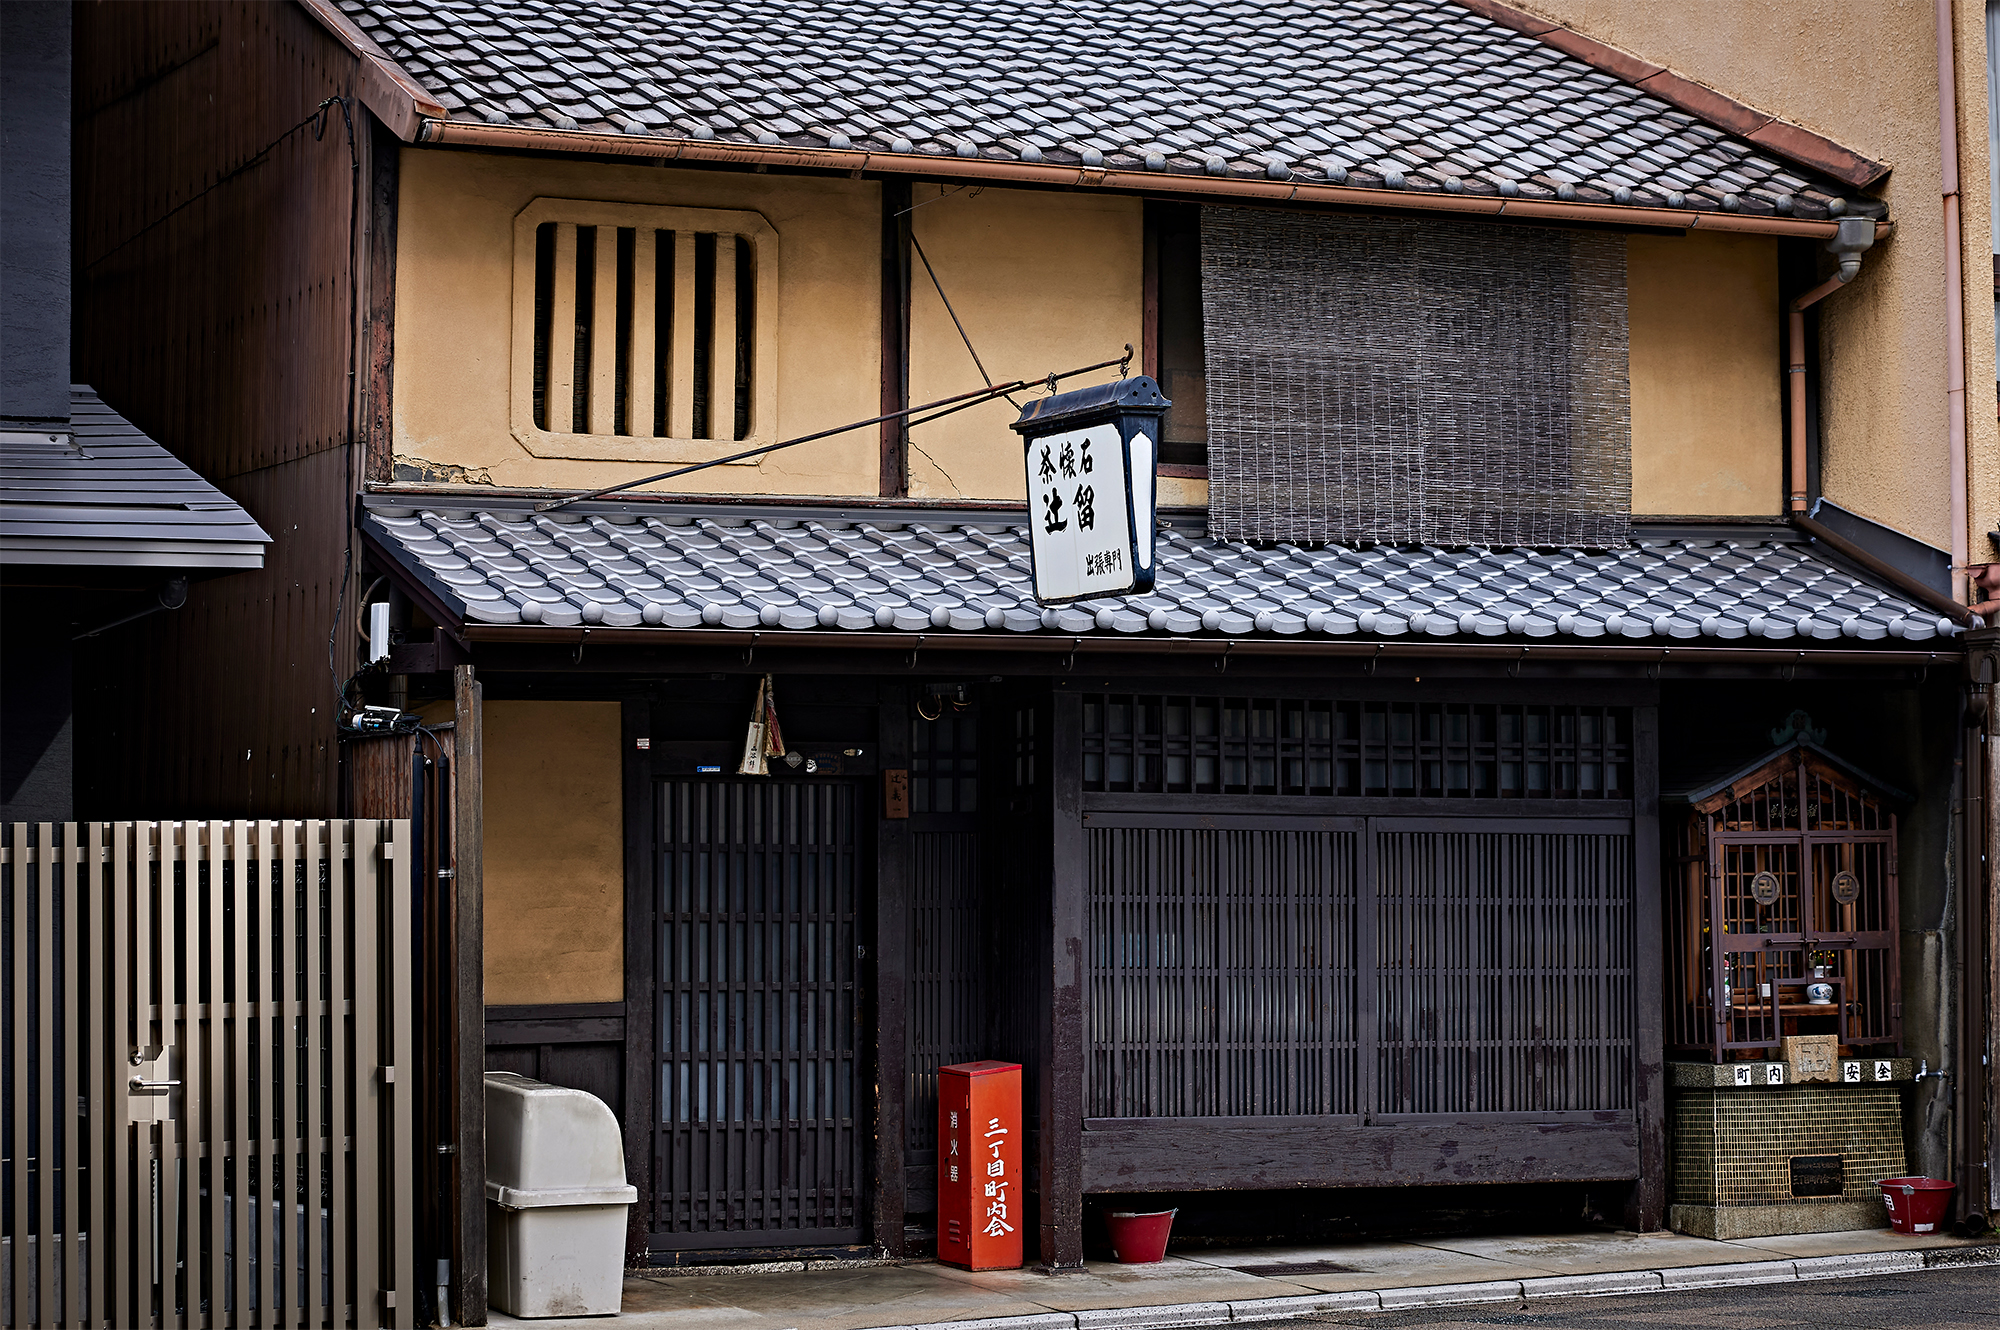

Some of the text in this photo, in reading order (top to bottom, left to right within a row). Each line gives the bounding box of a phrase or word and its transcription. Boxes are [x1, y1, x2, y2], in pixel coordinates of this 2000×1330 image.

[1038, 438, 1093, 484] 茶懐石
[1043, 484, 1095, 535] 辻留
[1086, 548, 1122, 576] 出張専門
[1737, 1062, 1891, 1083] 町内 安全
[950, 1112, 959, 1182] 消火器
[983, 1118, 1014, 1237] 三丁目町内会
